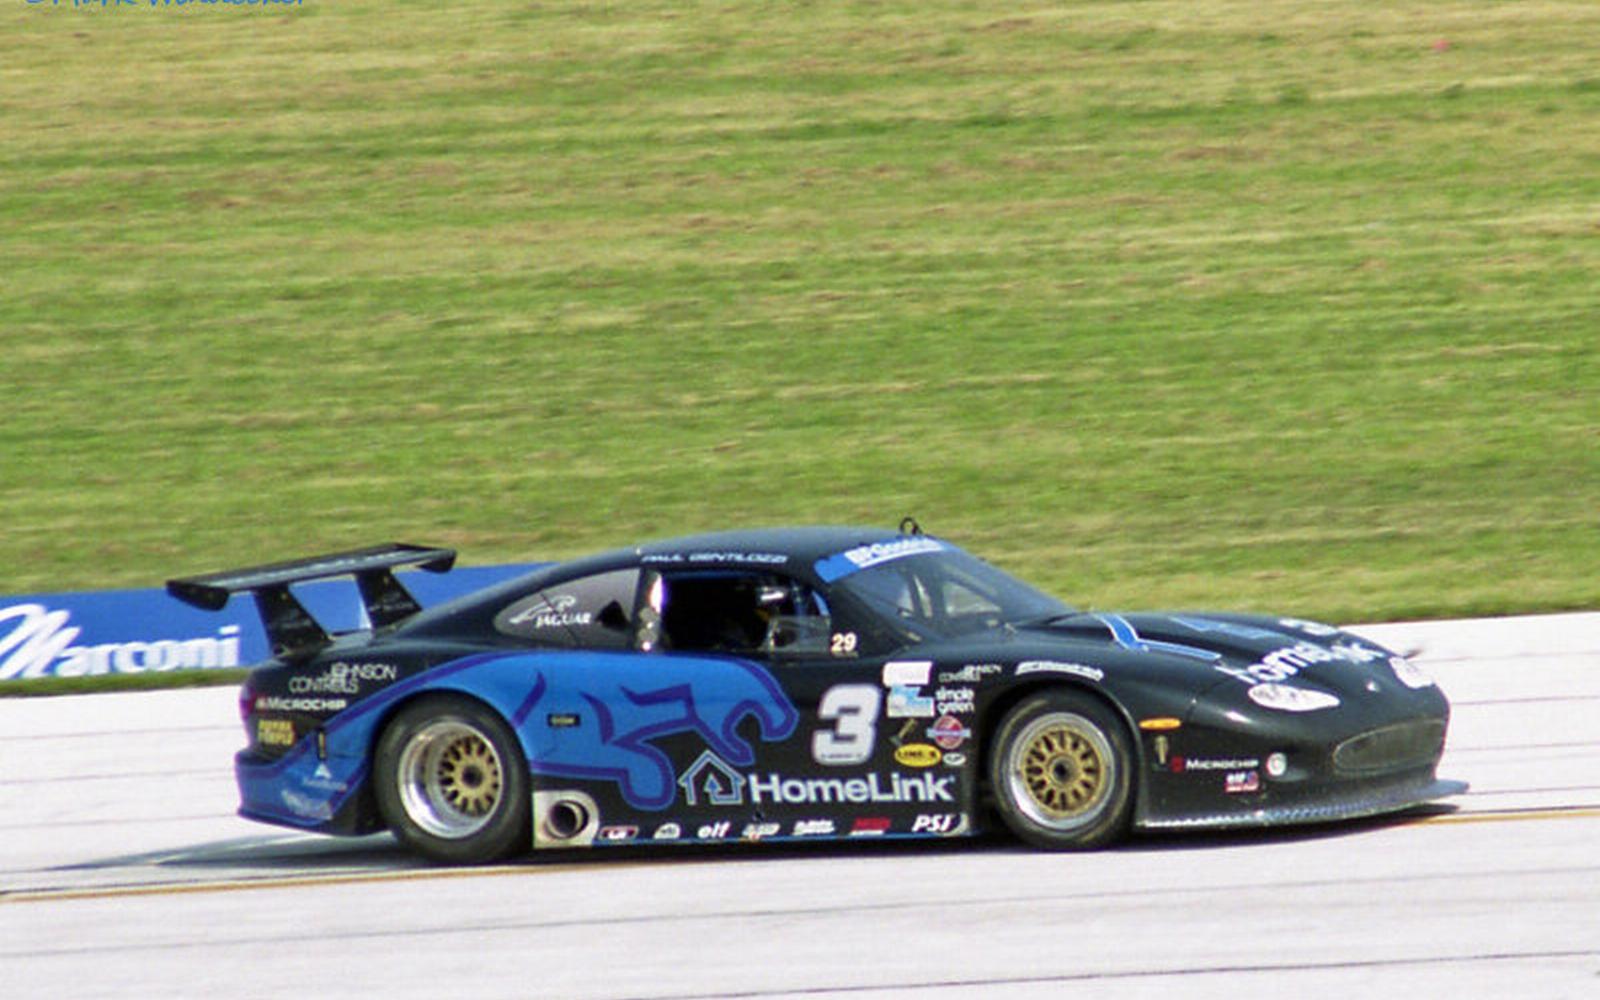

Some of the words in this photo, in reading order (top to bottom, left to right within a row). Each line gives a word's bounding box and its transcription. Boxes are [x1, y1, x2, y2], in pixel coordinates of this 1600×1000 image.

[536, 611, 591, 629] JAGUAR
[0, 603, 241, 681] Marconi
[830, 632, 857, 652] 29
[331, 661, 396, 681] JOHNSON
[288, 676, 360, 694] CONTROLS
[812, 683, 881, 765] 3
[748, 774, 953, 805] HomeLink
[697, 820, 731, 839] elf
[911, 813, 955, 833] PSI
